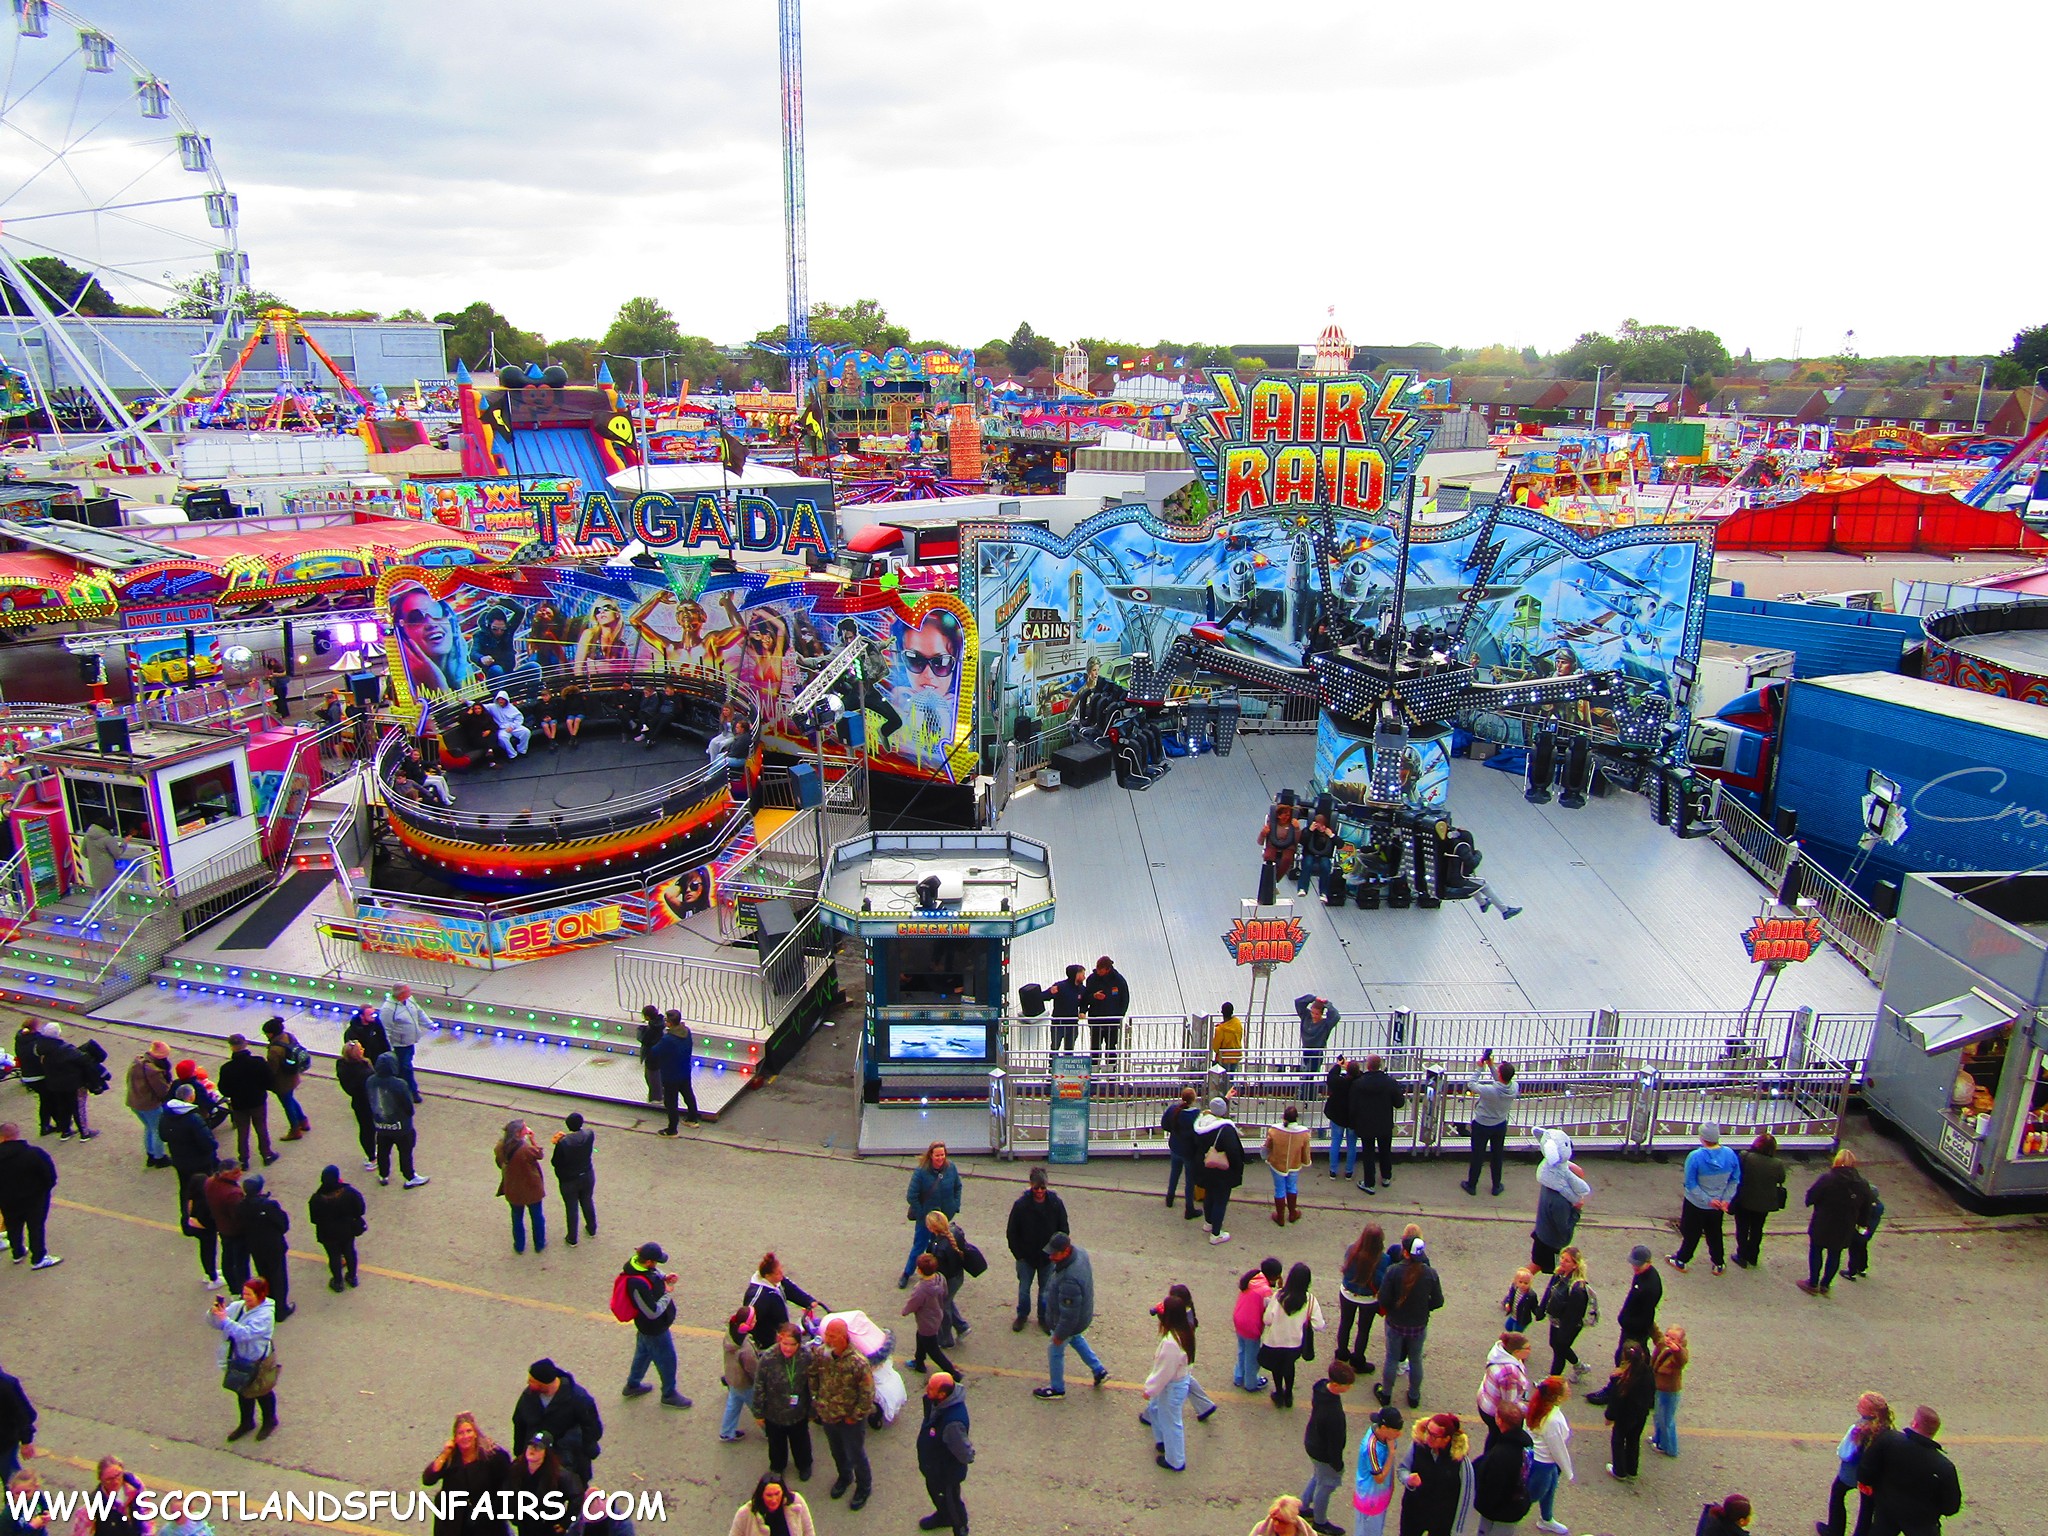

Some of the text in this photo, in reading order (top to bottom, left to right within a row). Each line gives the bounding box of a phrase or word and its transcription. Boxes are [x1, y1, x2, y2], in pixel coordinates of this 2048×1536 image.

[1249, 379, 1367, 444] AIR
[1222, 445, 1387, 518] RAID
[484, 511, 535, 531] PRIZES
[520, 491, 837, 564] TAGADA
[128, 607, 210, 628] DRIVE ALL DAY
[1029, 609, 1053, 622] CAFE
[1022, 622, 1071, 641] CABINS
[505, 903, 623, 957] BE ONE
[897, 922, 971, 936] CHECK IN
[1246, 920, 1288, 941] AIR
[1765, 919, 1807, 940] AIR
[418, 922, 487, 959] ONLY
[1752, 939, 1811, 962] RAID
[1237, 940, 1295, 965] RAID
[1952, 1130, 1968, 1146] HOT
[1952, 1140, 1971, 1158] COLD
